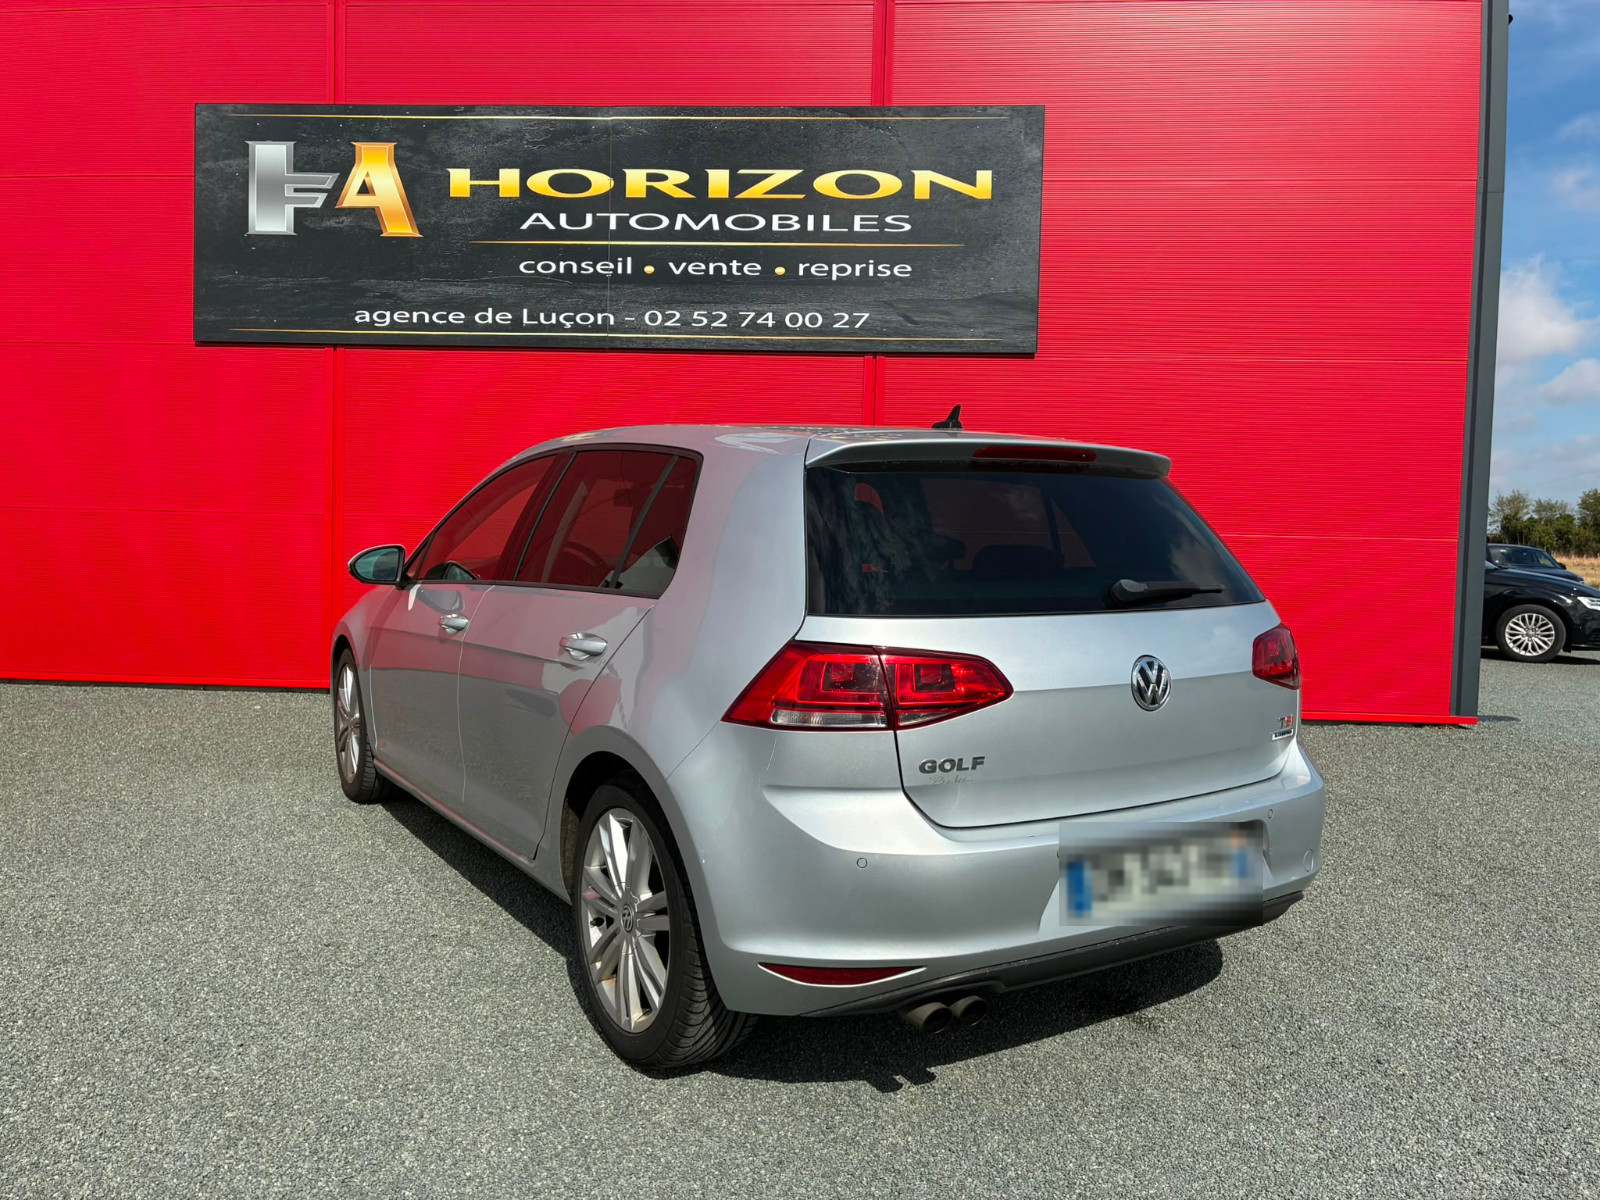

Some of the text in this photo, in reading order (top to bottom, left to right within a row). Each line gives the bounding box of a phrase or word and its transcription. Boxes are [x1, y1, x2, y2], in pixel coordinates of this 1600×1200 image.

[448, 168, 993, 200] HORIZON
[519, 212, 912, 234] AUTOMOBILES
[518, 257, 913, 280] conseil vente reprise
[354, 309, 466, 328] agence
[474, 308, 513, 325] de
[522, 309, 615, 330] Luçon
[643, 309, 682, 327] 02
[691, 311, 728, 328] 52
[739, 311, 776, 328] 74
[784, 312, 823, 329] 00
[832, 312, 871, 330] 27
[919, 756, 985, 774] GOLF
